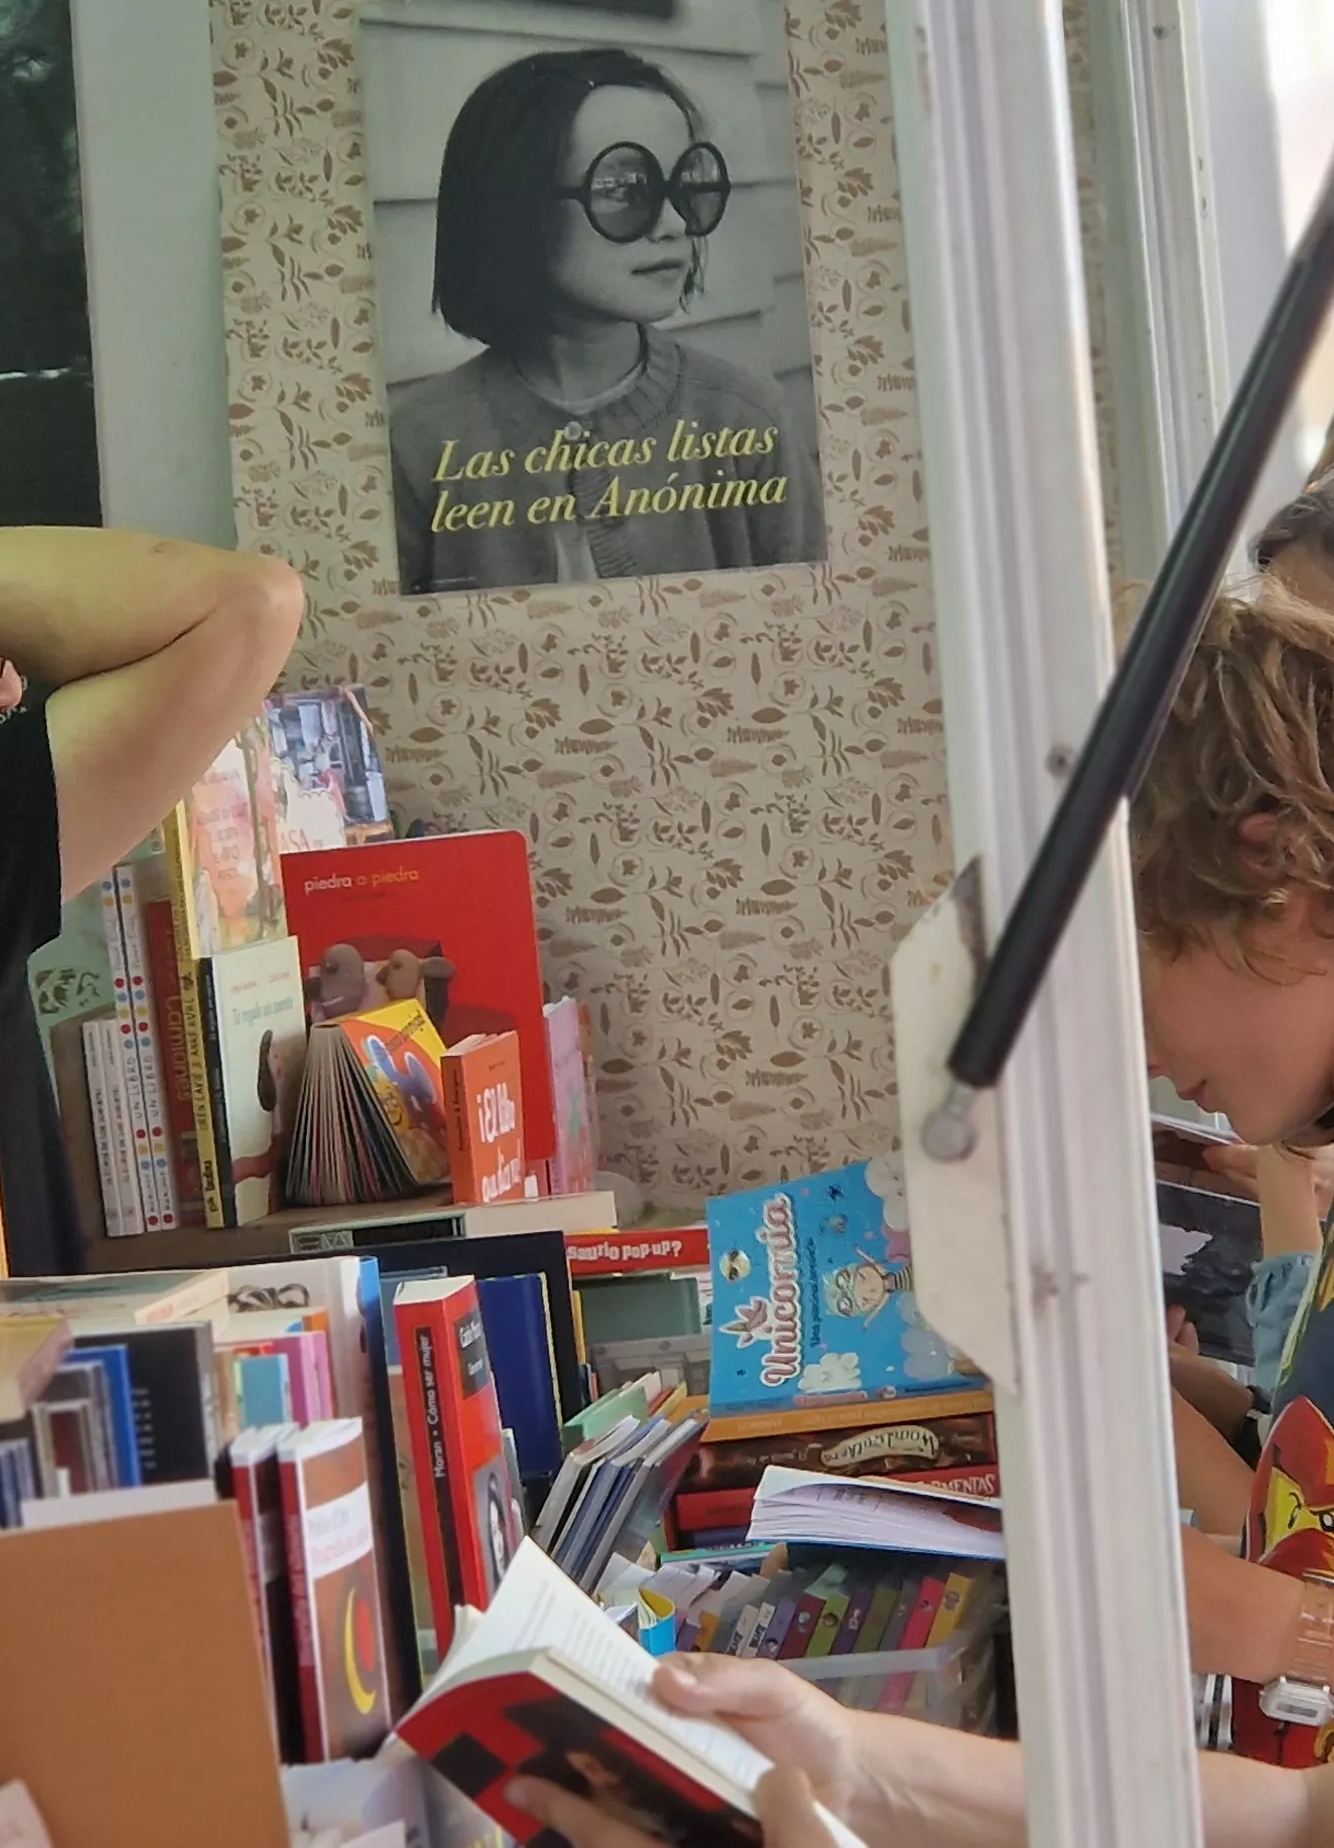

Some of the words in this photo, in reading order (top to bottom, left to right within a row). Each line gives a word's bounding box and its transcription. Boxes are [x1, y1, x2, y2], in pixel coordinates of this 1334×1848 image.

[431, 439, 515, 482] Las
[524, 430, 657, 473] chicas
[667, 419, 779, 464] listas
[431, 491, 515, 533] leen
[527, 492, 578, 524] en
[591, 470, 788, 520] Anónima
[304, 873, 352, 895] piedra
[373, 865, 418, 888] piedra
[756, 1192, 802, 1387] Unicornia
[419, 1335, 434, 1367] mujer
[424, 1370, 434, 1388] ser
[425, 1390, 439, 1425] Cómo
[433, 1441, 447, 1478] Moran
